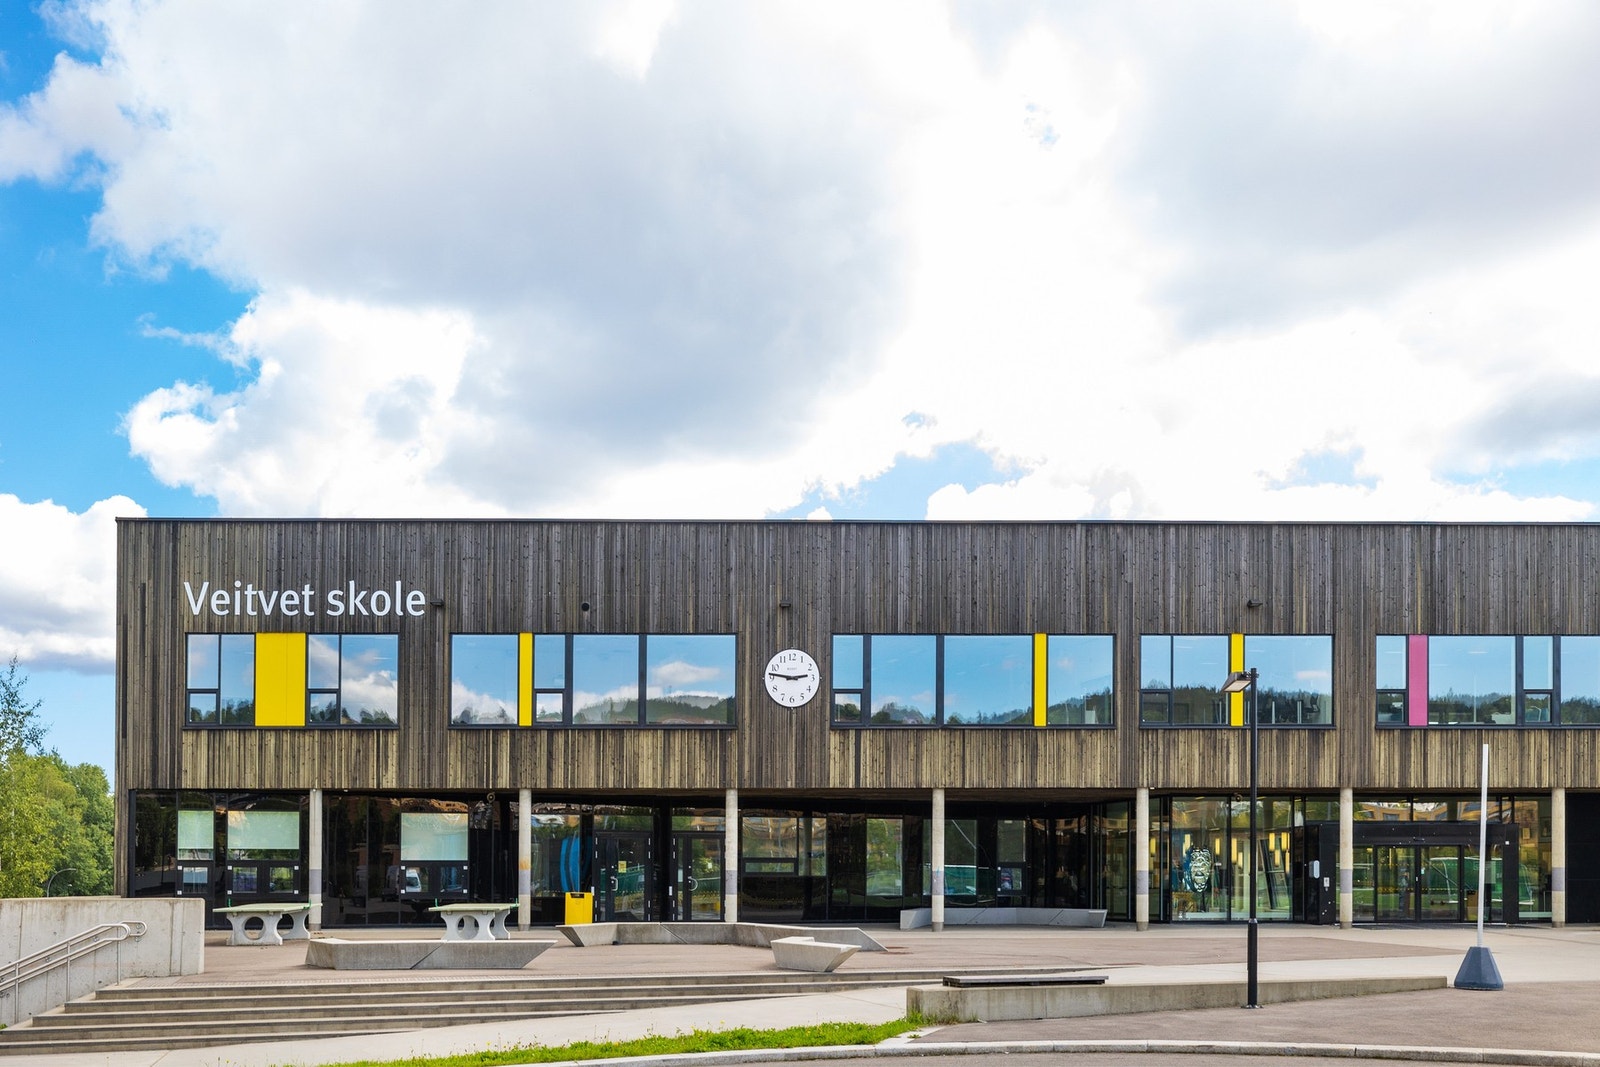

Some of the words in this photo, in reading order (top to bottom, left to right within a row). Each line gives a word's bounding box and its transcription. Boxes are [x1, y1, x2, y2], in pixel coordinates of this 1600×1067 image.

[183, 580, 315, 616] Veitvet
[326, 580, 426, 616] skole
[788, 653, 796, 661] 12
[772, 664, 780, 672] 10
[780, 693, 786, 701] 7
